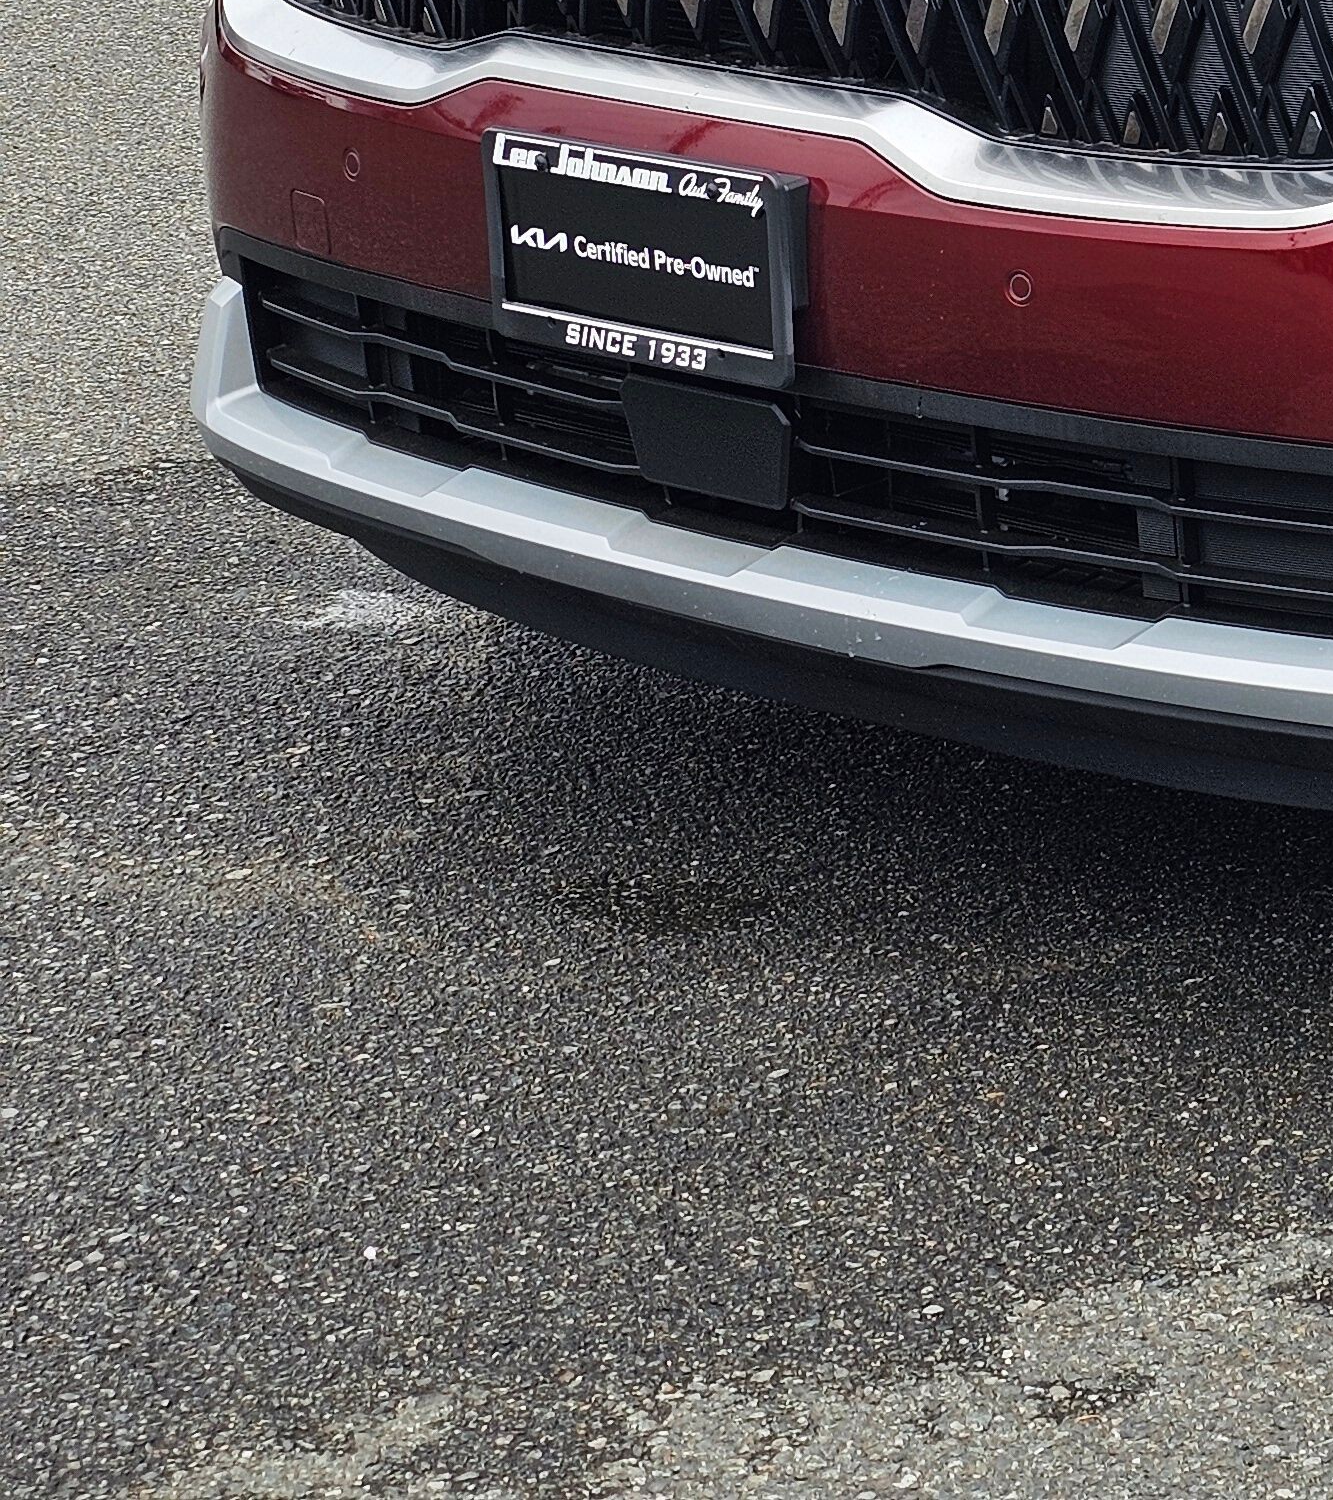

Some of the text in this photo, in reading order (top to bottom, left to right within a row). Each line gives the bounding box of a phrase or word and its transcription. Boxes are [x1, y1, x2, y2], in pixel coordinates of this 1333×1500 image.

[550, 143, 672, 193] Johnson
[679, 172, 714, 200] Aut
[713, 177, 764, 218] Family
[573, 235, 651, 270] Certified
[565, 323, 707, 370] SINCE 1933
